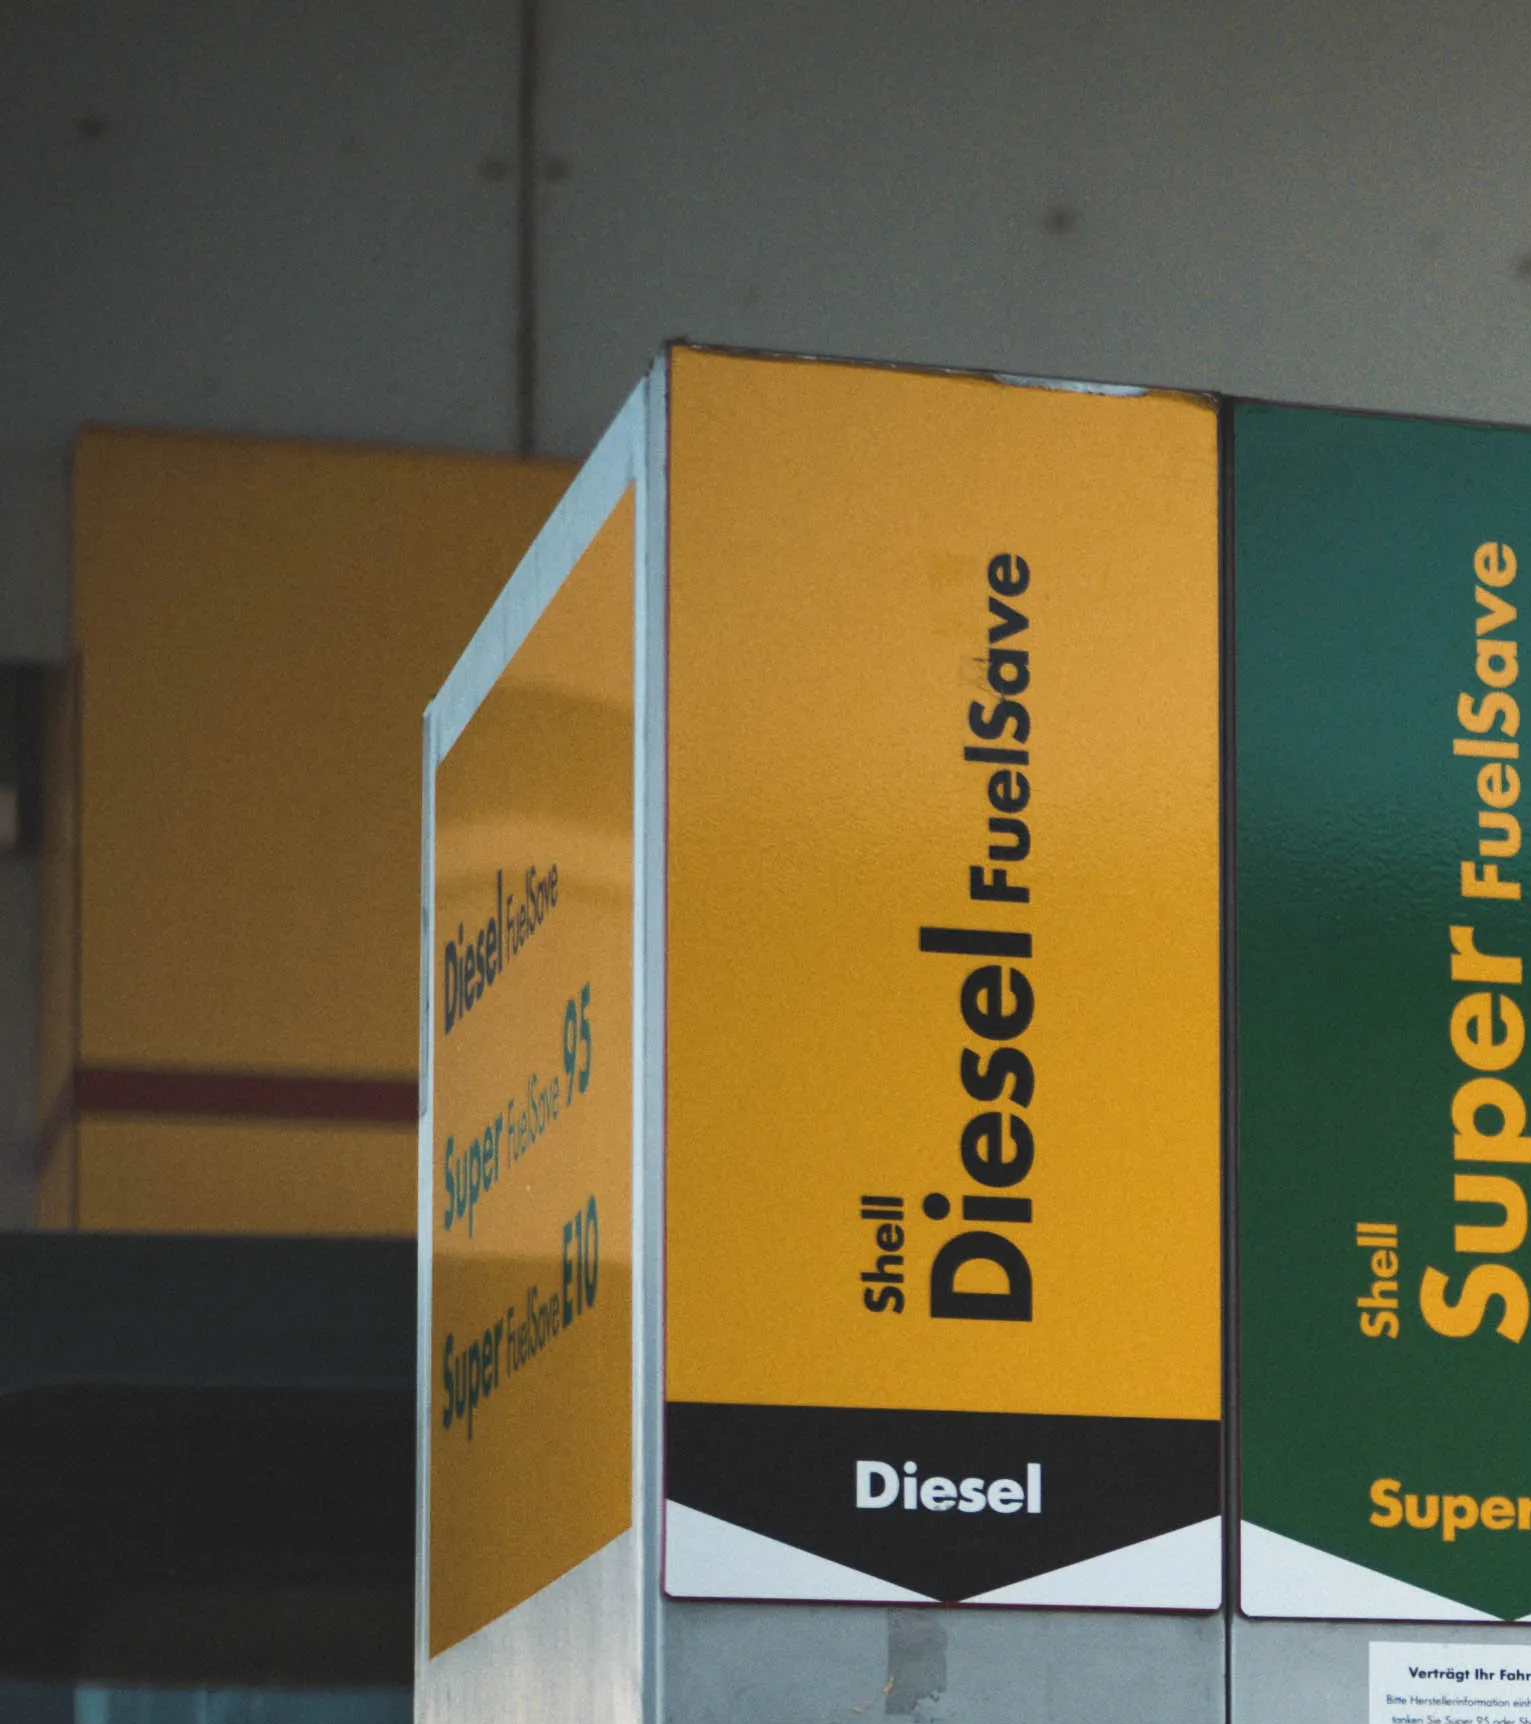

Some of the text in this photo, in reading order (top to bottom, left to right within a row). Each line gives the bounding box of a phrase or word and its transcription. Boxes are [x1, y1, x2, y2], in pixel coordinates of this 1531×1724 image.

[1453, 541, 1522, 901] FuelSave
[444, 864, 558, 1034] Diesel FuelSave
[918, 553, 1035, 1322] Diesel FuelSave
[444, 982, 592, 1237] Super FuelSave 95
[861, 1194, 904, 1314] Shell
[1356, 1221, 1398, 1339] Shell
[442, 1196, 599, 1441] Super FuelSave E10
[855, 1460, 1042, 1515] Diesel
[1386, 1695, 1407, 1705] Bitte
[1410, 1695, 1510, 1707] Herstellerinformation
[1392, 1716, 1423, 1724] tanken
[1427, 1716, 1441, 1724] Sie
[1409, 1667, 1469, 1683] Verträgt
[1475, 1669, 1495, 1681] Ihr
